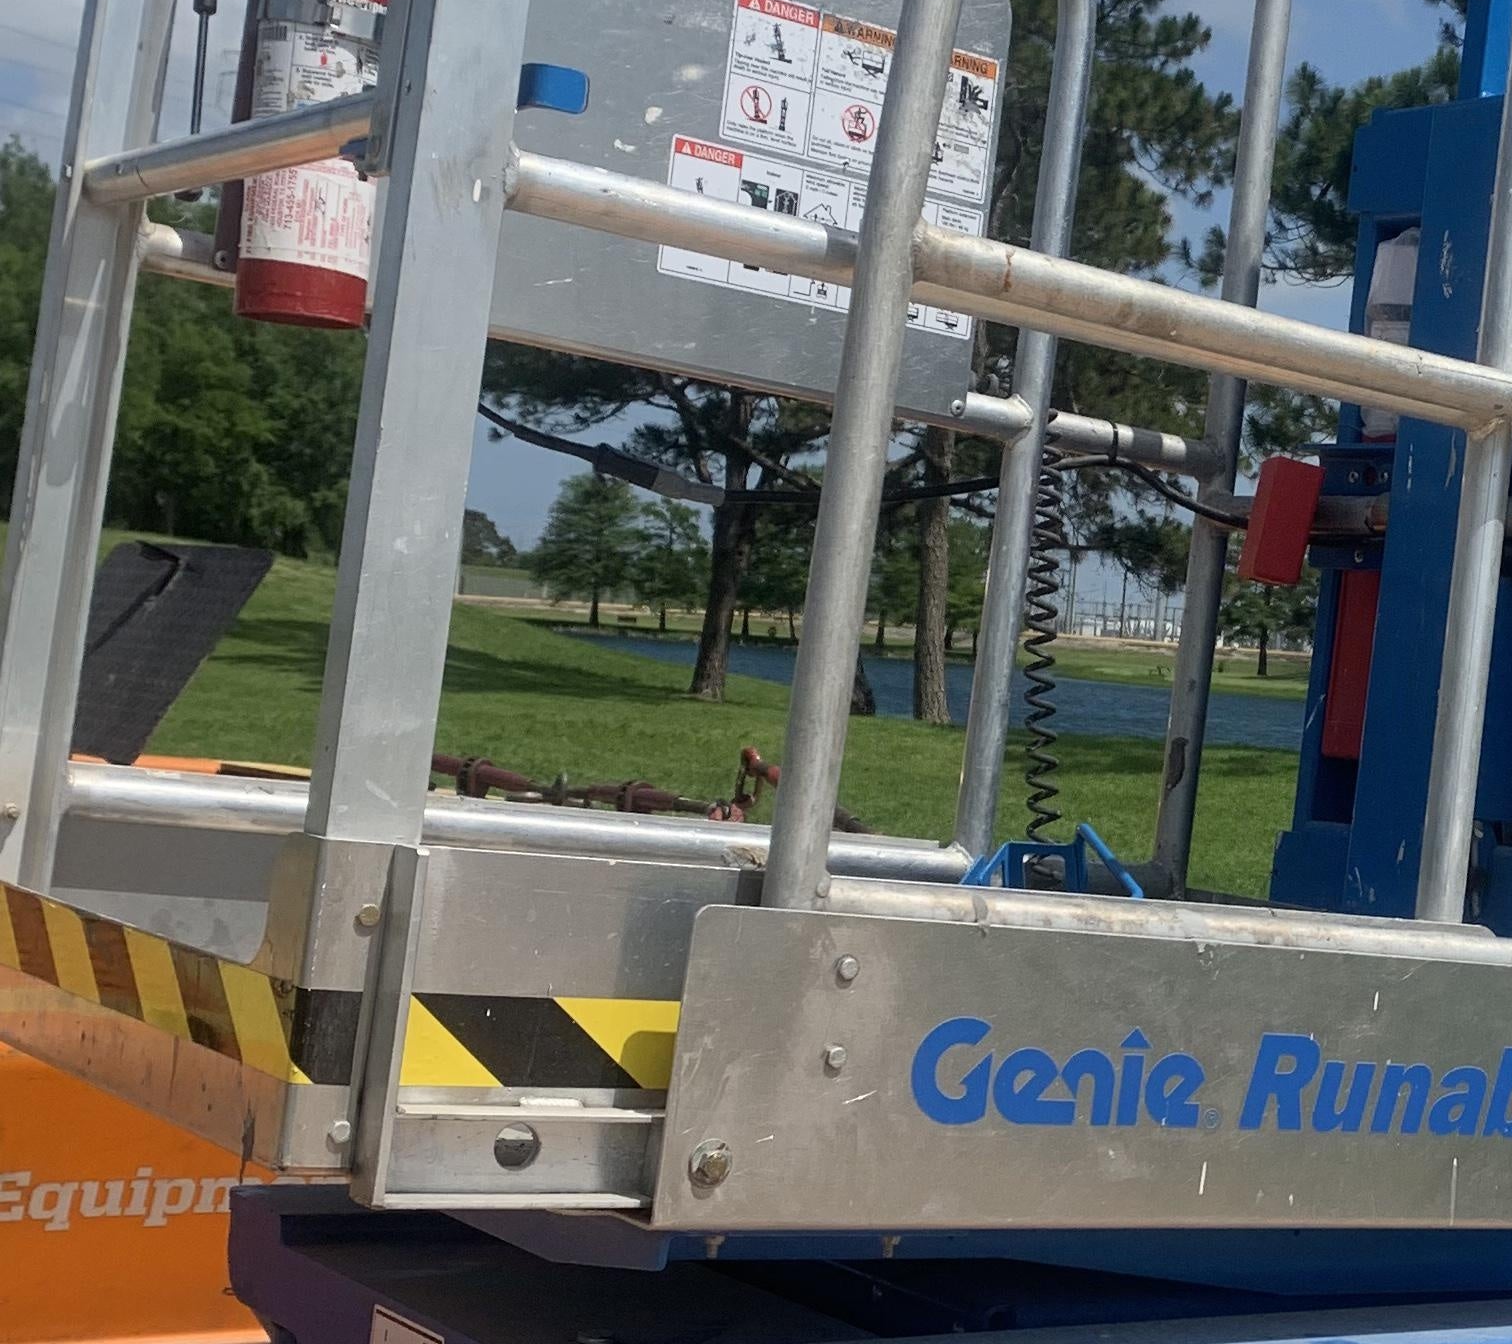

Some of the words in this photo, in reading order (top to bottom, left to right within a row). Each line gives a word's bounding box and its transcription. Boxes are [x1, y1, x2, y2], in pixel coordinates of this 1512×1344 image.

[764, 1, 814, 25] DANGER
[693, 144, 735, 165] DANGER
[911, 1015, 1206, 1129] Genie
